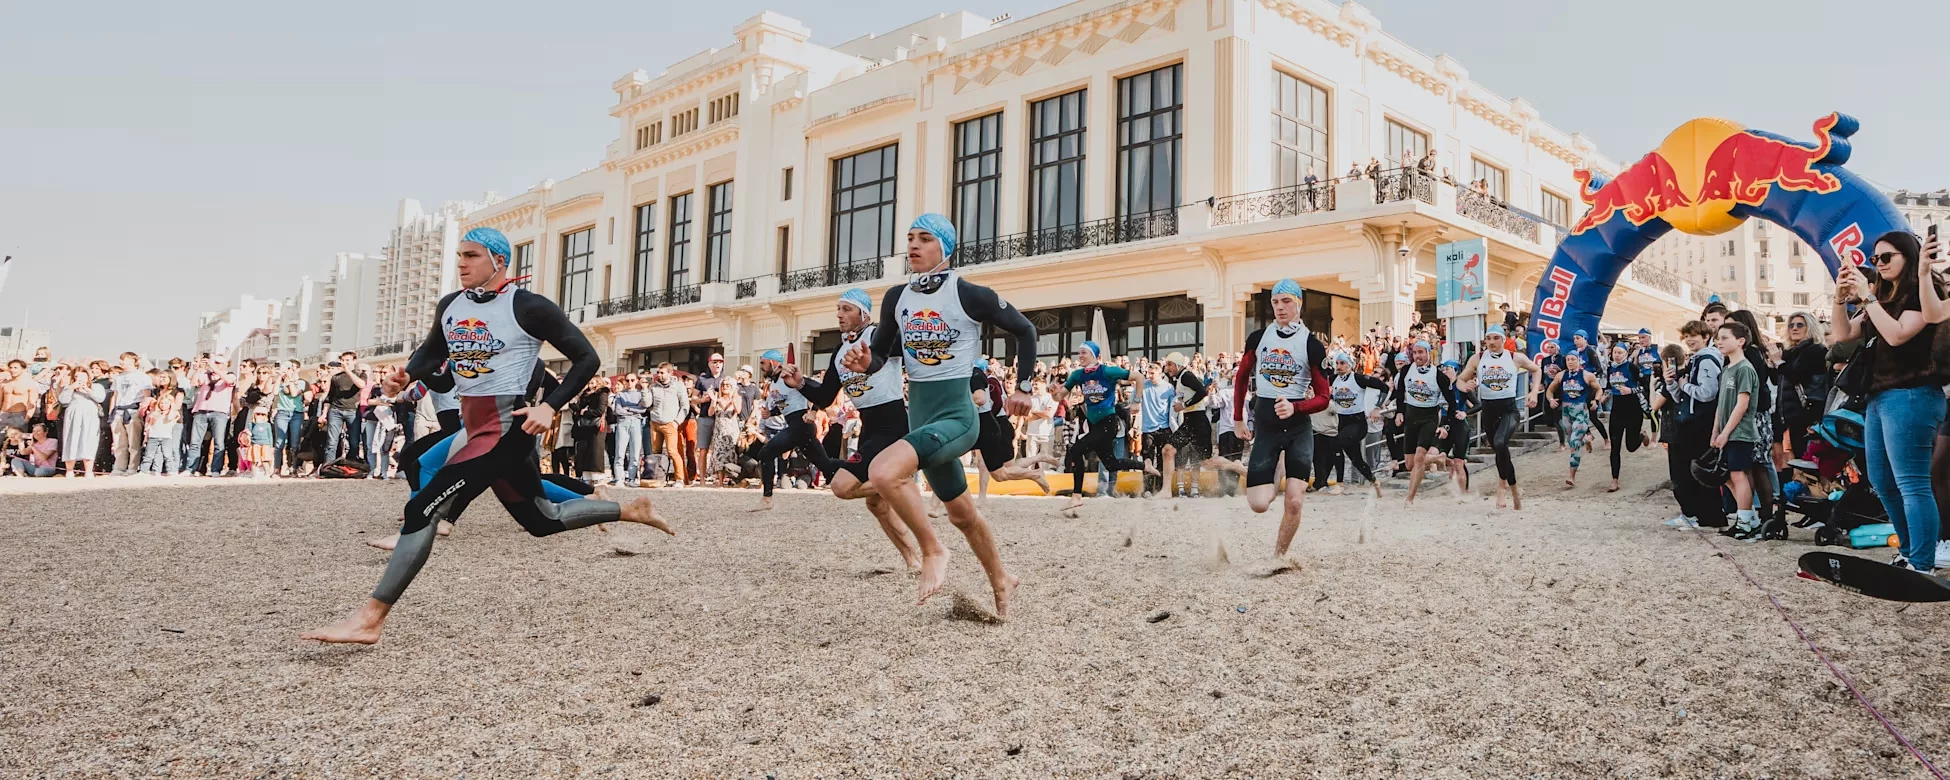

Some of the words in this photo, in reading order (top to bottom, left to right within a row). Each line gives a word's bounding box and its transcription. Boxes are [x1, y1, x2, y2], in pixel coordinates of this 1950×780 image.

[1829, 222, 1868, 268] Re
[1540, 265, 1577, 319] Bull
[448, 331, 468, 341] Red
[470, 331, 490, 341] Bull
[905, 332, 951, 342] OCEAN
[906, 321, 925, 331] Red
[926, 322, 947, 331] Bull
[423, 479, 466, 517] SNUGG
